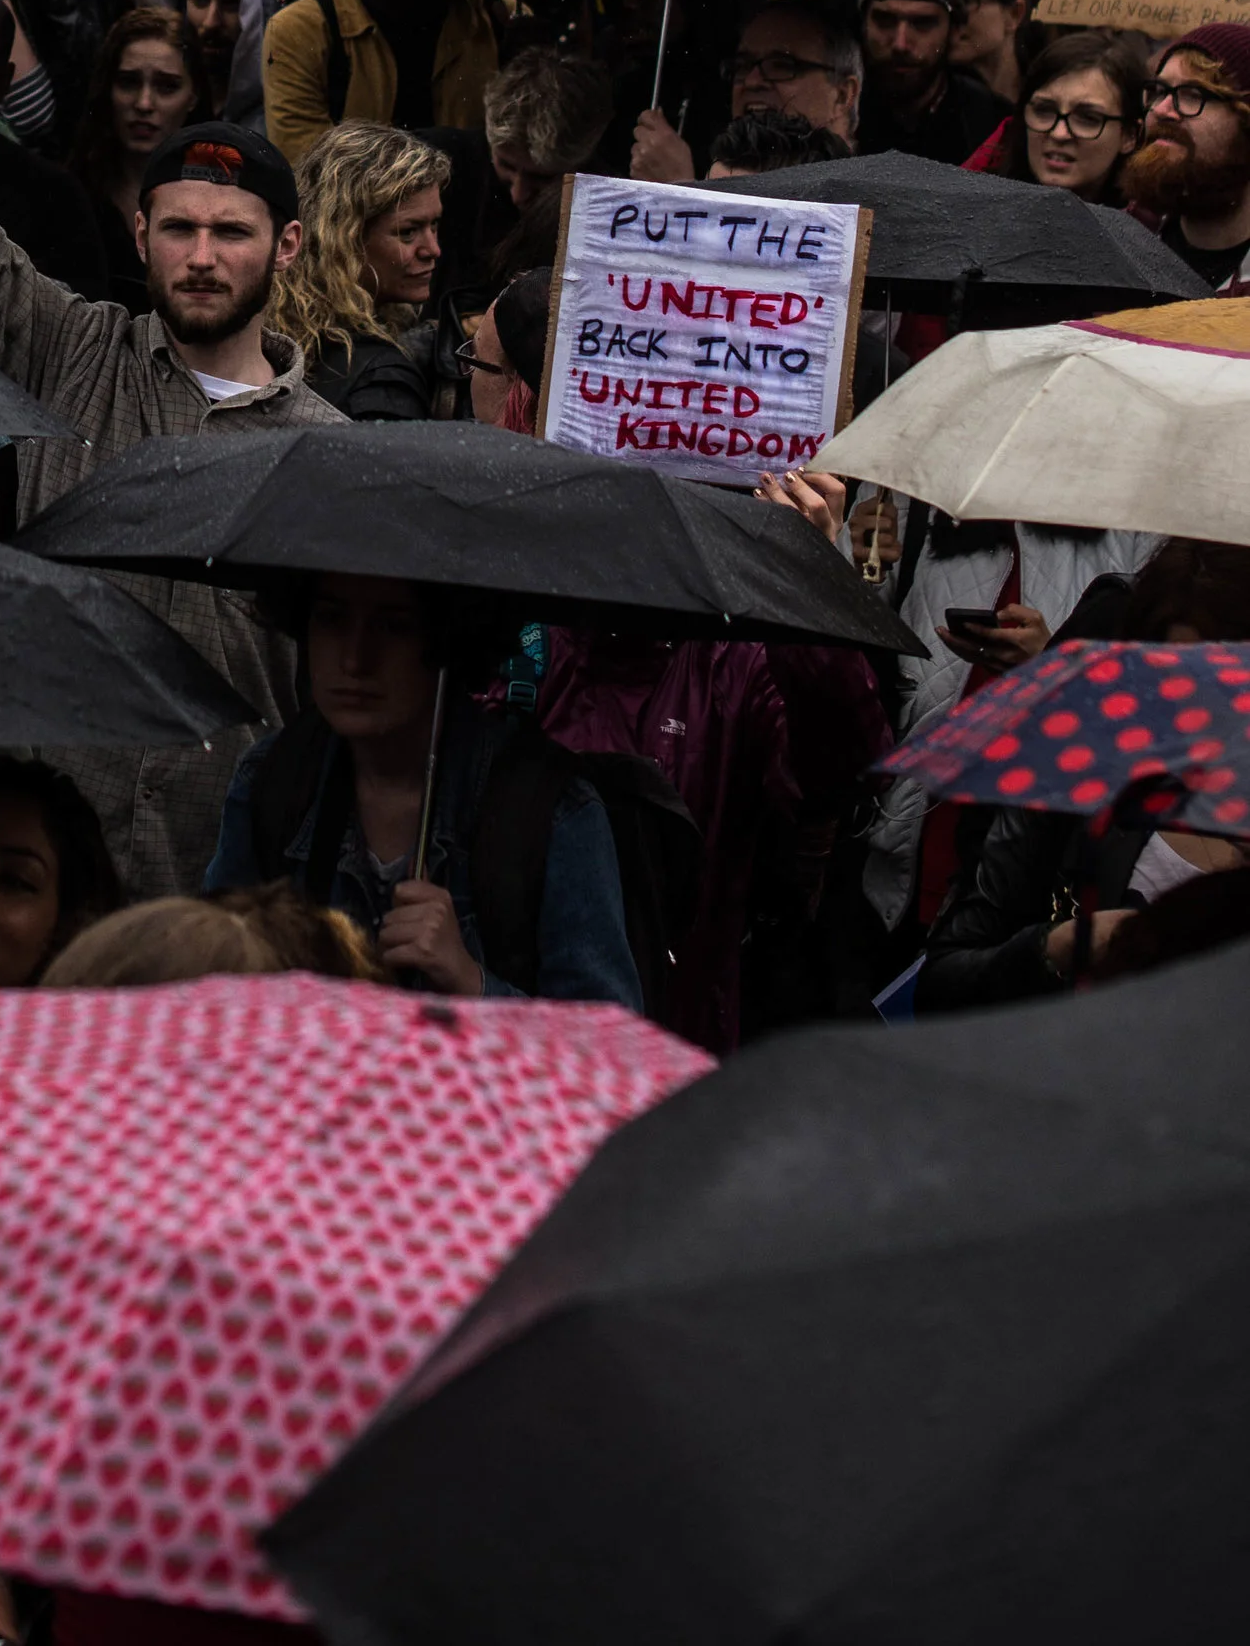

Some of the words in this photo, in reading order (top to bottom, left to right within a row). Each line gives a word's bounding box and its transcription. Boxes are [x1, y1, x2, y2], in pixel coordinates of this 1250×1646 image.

[1089, 0, 1122, 18] OUR
[610, 204, 708, 242] PUT
[720, 216, 826, 261] THE
[608, 273, 825, 330] 'UNITED'
[578, 318, 668, 361] BACK
[693, 336, 810, 374] INTO
[571, 367, 761, 418] 'UNITED
[615, 412, 826, 464] KINGDOM'
